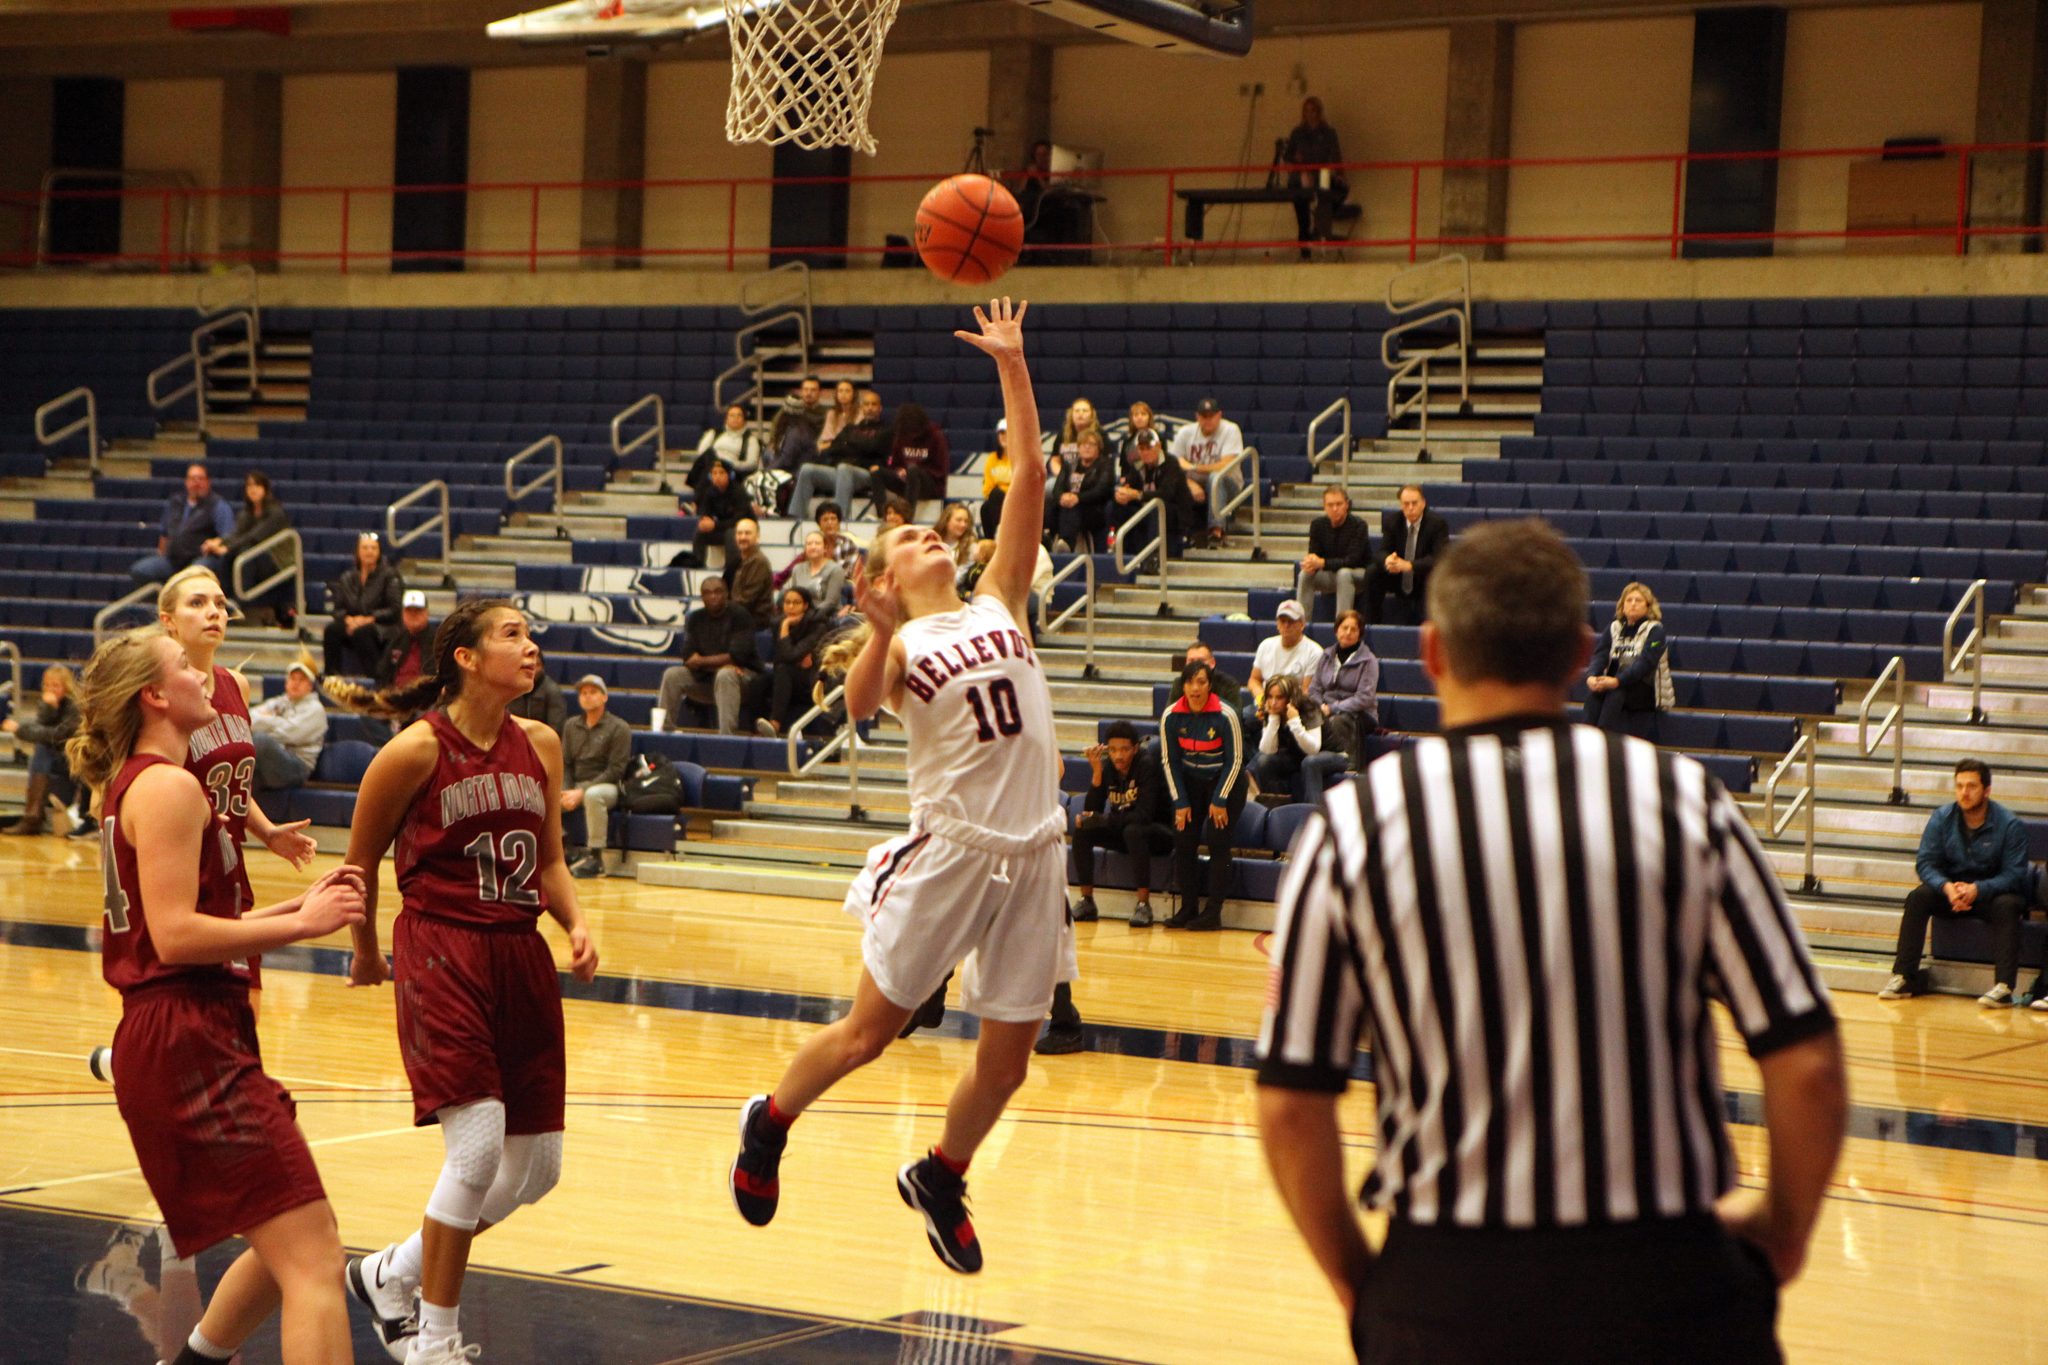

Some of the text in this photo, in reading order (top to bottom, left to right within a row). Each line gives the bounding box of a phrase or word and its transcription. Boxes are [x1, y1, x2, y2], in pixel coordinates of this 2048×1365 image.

[905, 629, 1035, 704] BELLEVU
[189, 714, 230, 763] NORTH
[966, 678, 1022, 742] 10
[207, 757, 255, 816] 33
[441, 772, 546, 829] NORTH IDAH
[100, 816, 130, 934] 4
[464, 829, 540, 905] 12
